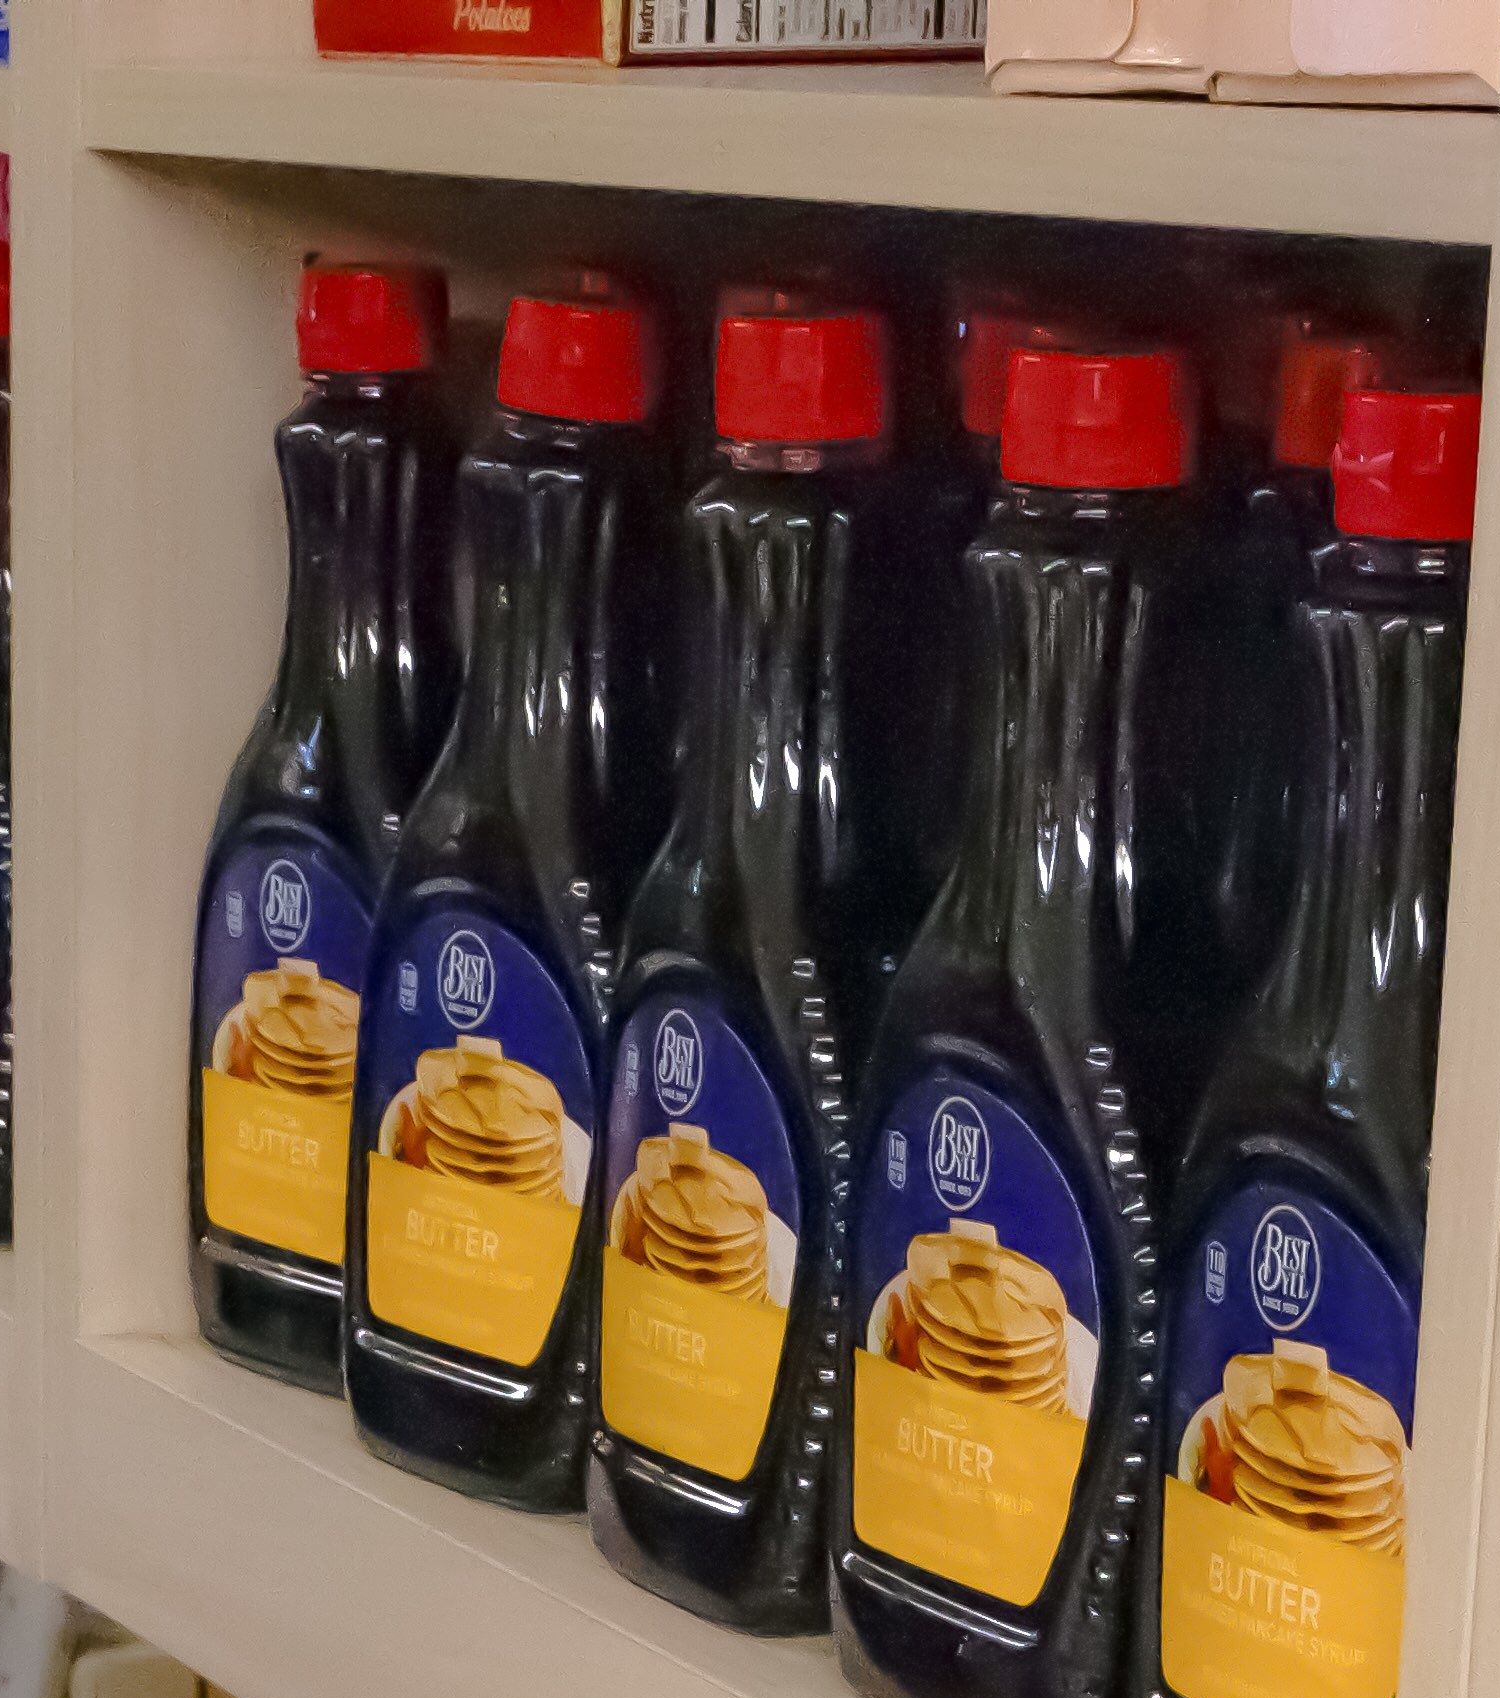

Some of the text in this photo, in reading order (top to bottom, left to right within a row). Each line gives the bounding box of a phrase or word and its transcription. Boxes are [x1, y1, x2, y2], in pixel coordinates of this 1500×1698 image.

[404, 1206, 501, 1263] BUTTER
[1258, 1223, 1311, 1291] BEST
[897, 1416, 994, 1485] BUTTER
[1208, 1551, 1321, 1631] BUTTER
